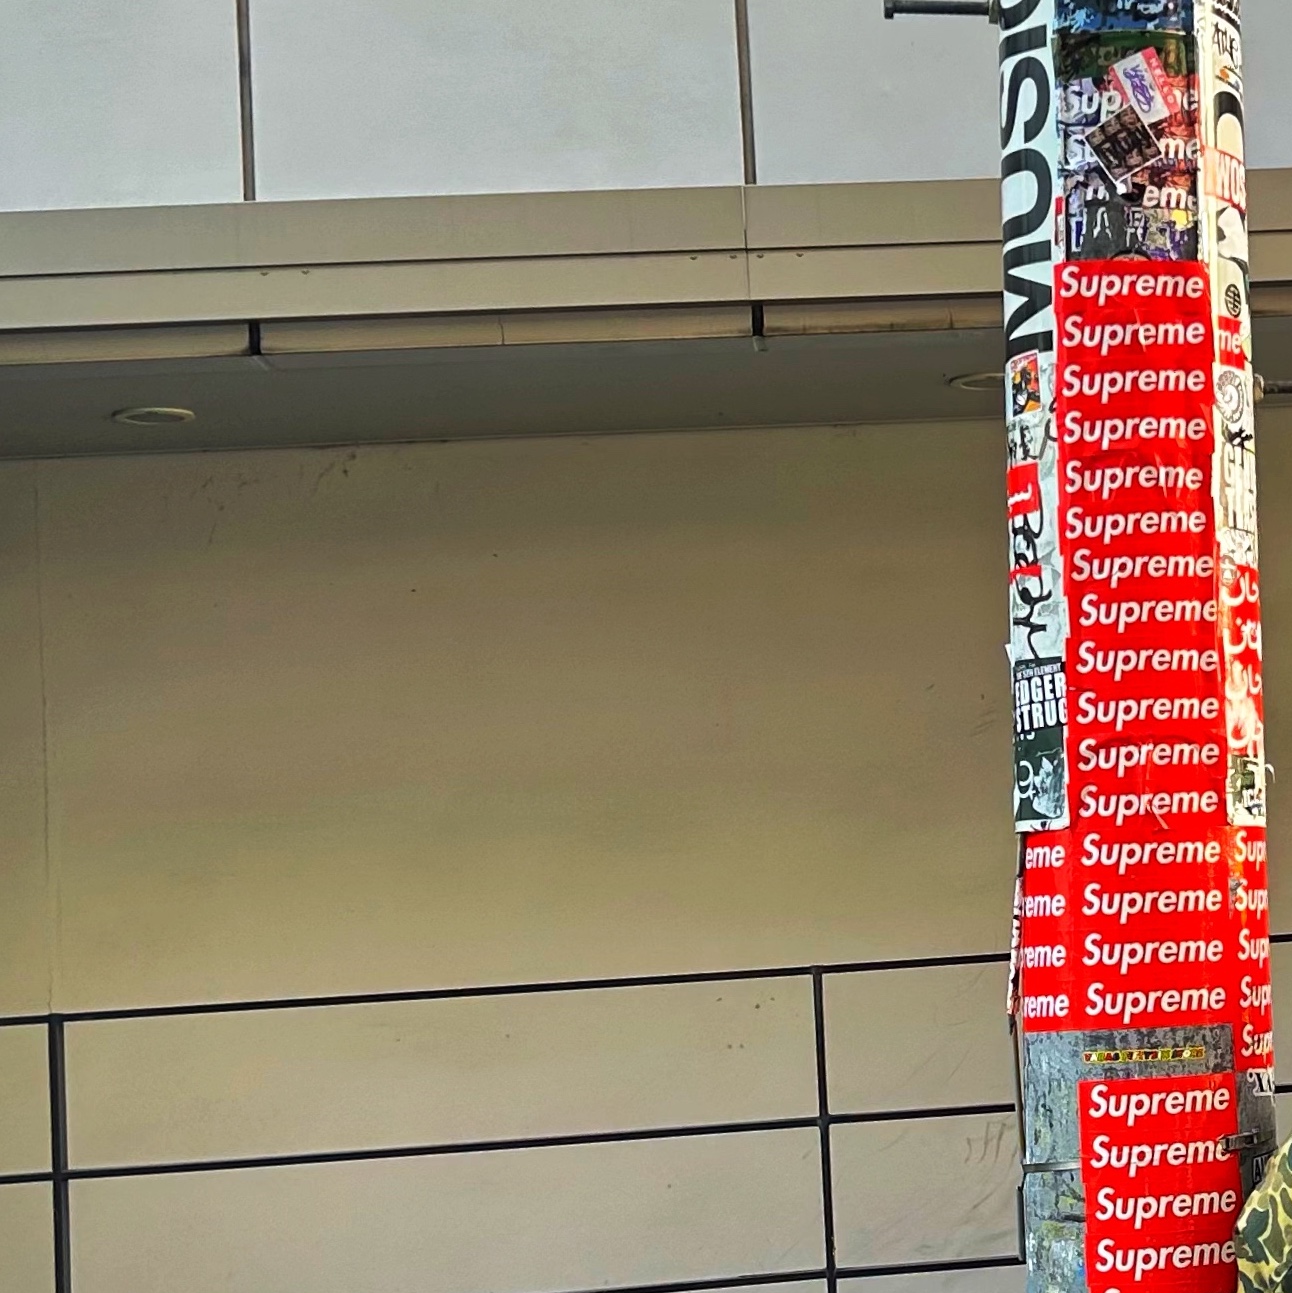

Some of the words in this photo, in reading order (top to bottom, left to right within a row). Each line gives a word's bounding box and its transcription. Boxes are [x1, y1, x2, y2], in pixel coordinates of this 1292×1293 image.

[1060, 266, 1204, 306] Supreme
[1062, 316, 1206, 356] Supreme
[1062, 365, 1206, 404] Supreme
[1063, 411, 1207, 450] Supreme
[1065, 461, 1204, 499] Supreme
[1065, 507, 1207, 544] Supreme
[1071, 549, 1214, 588] Supreme
[1079, 594, 1217, 633] Supreme
[1076, 641, 1218, 681] Supreme
[1076, 692, 1219, 731] Supreme
[1078, 738, 1220, 777] Supreme
[1079, 785, 1218, 826] Supreme
[1081, 833, 1221, 875] Supreme
[1082, 883, 1223, 924] Supreme
[1082, 933, 1224, 975] Supreme
[1085, 983, 1226, 1024] Supreme
[1089, 1084, 1230, 1126] Supreme
[1095, 1187, 1236, 1229] Supreme
[1095, 1238, 1236, 1281] Supreme
